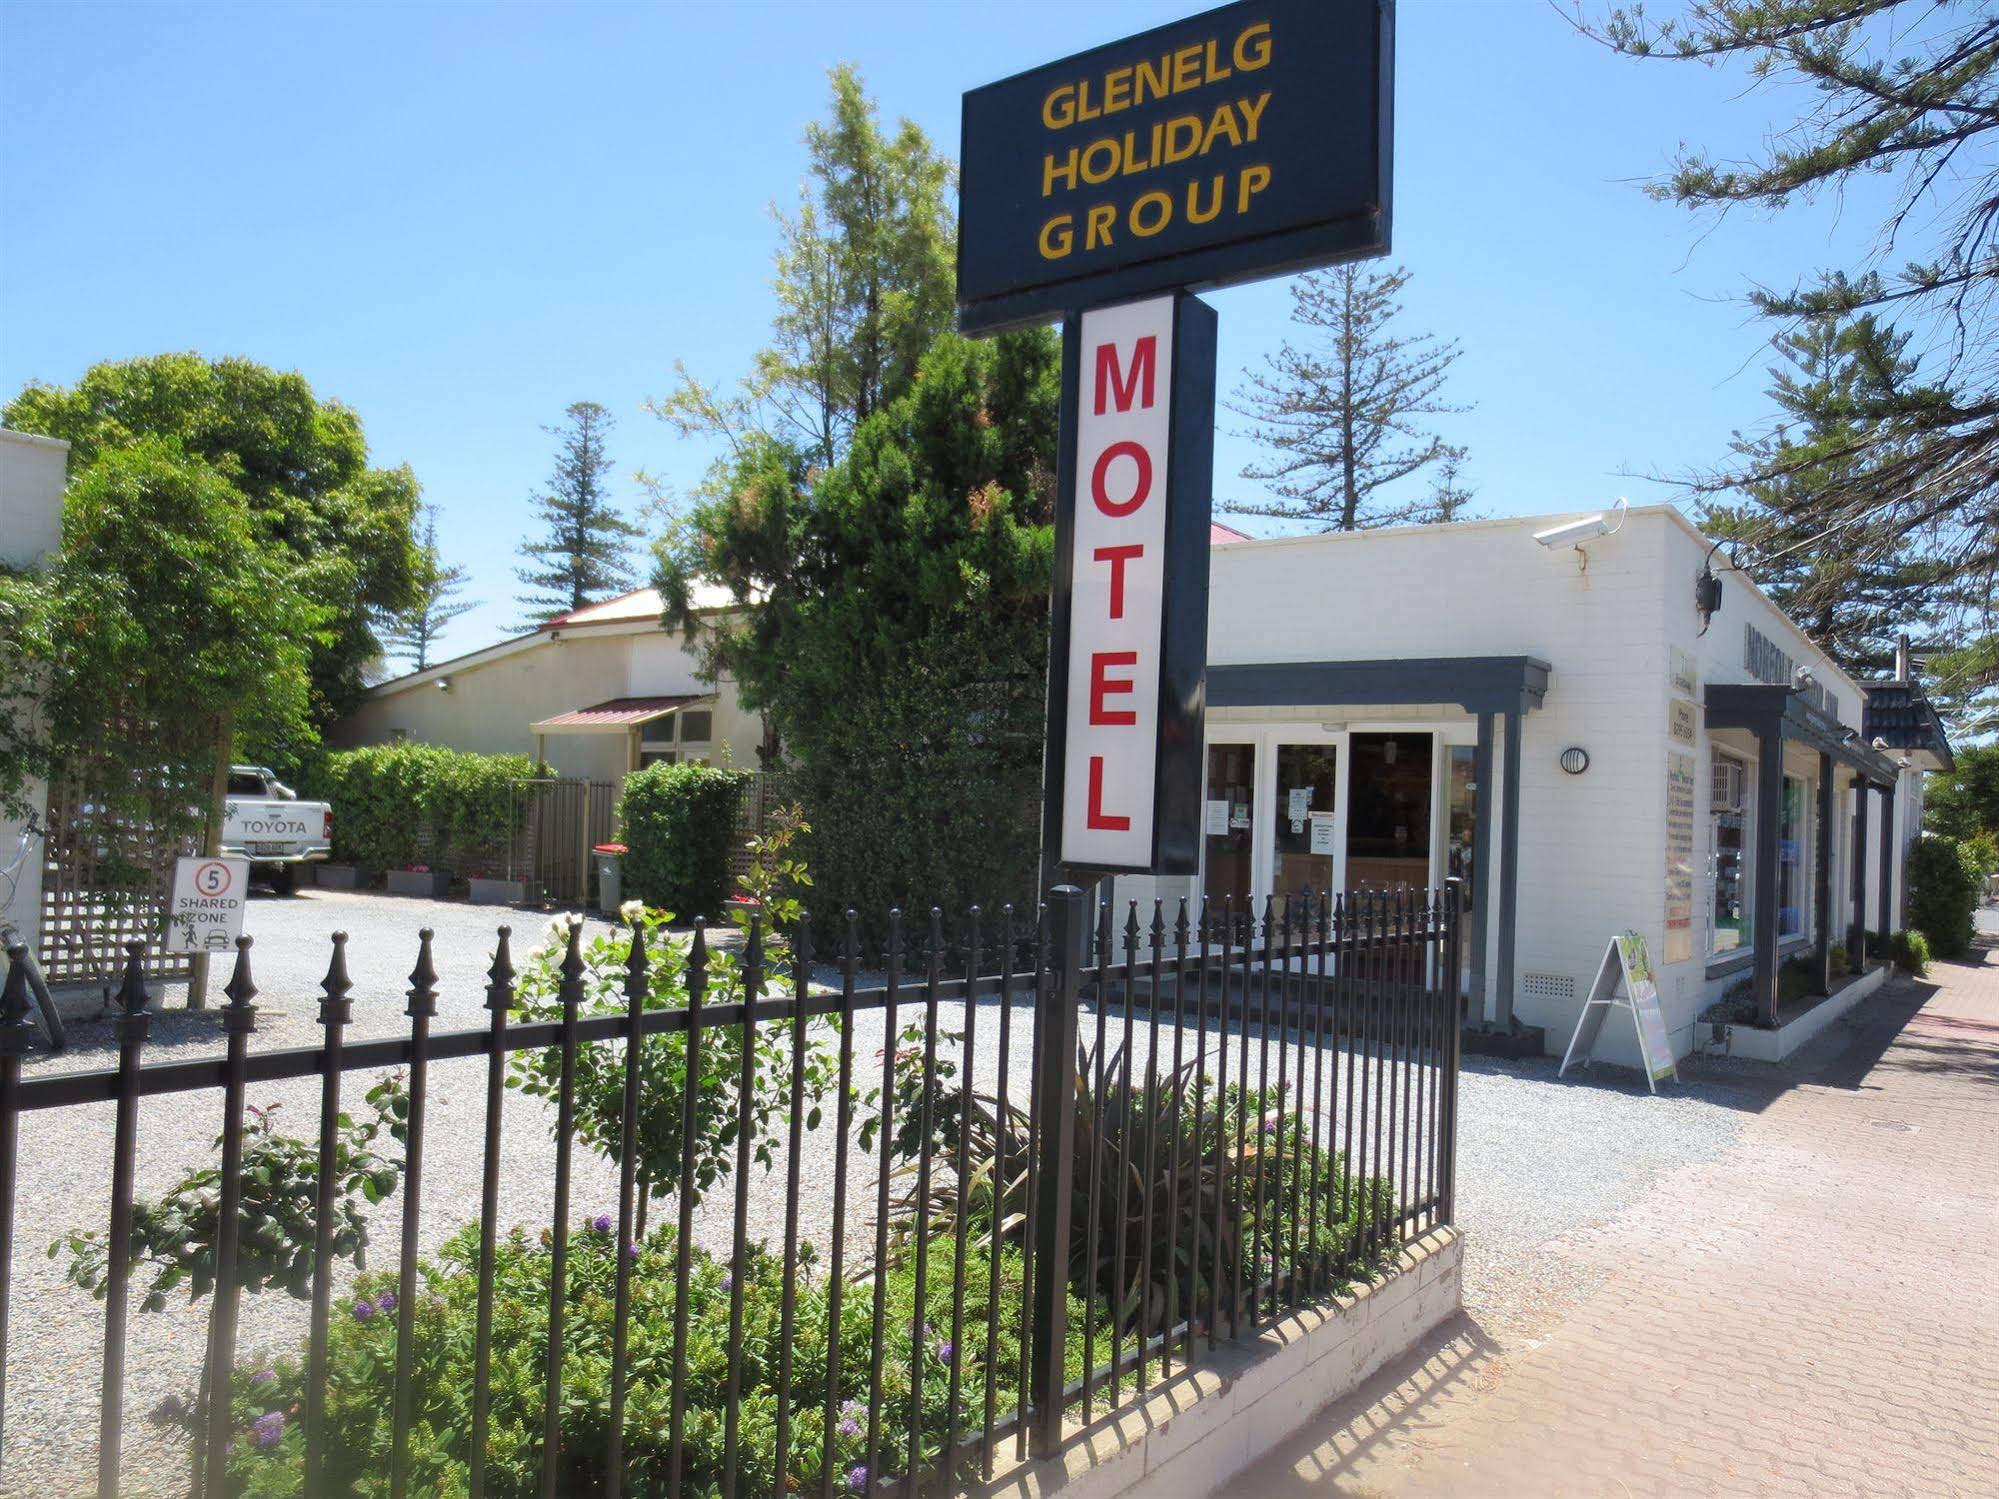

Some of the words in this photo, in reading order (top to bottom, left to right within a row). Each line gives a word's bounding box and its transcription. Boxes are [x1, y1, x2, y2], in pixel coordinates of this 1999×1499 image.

[1041, 23, 1273, 130] GLENELG
[1041, 93, 1273, 196] HOLIDAY
[1038, 165, 1273, 260] GROUP
[1087, 336, 1157, 831] MOTEL
[241, 820, 307, 834] TOYOTA
[179, 897, 238, 909] SHARED
[207, 870, 219, 889] 5
[187, 912, 228, 923] ZONE
